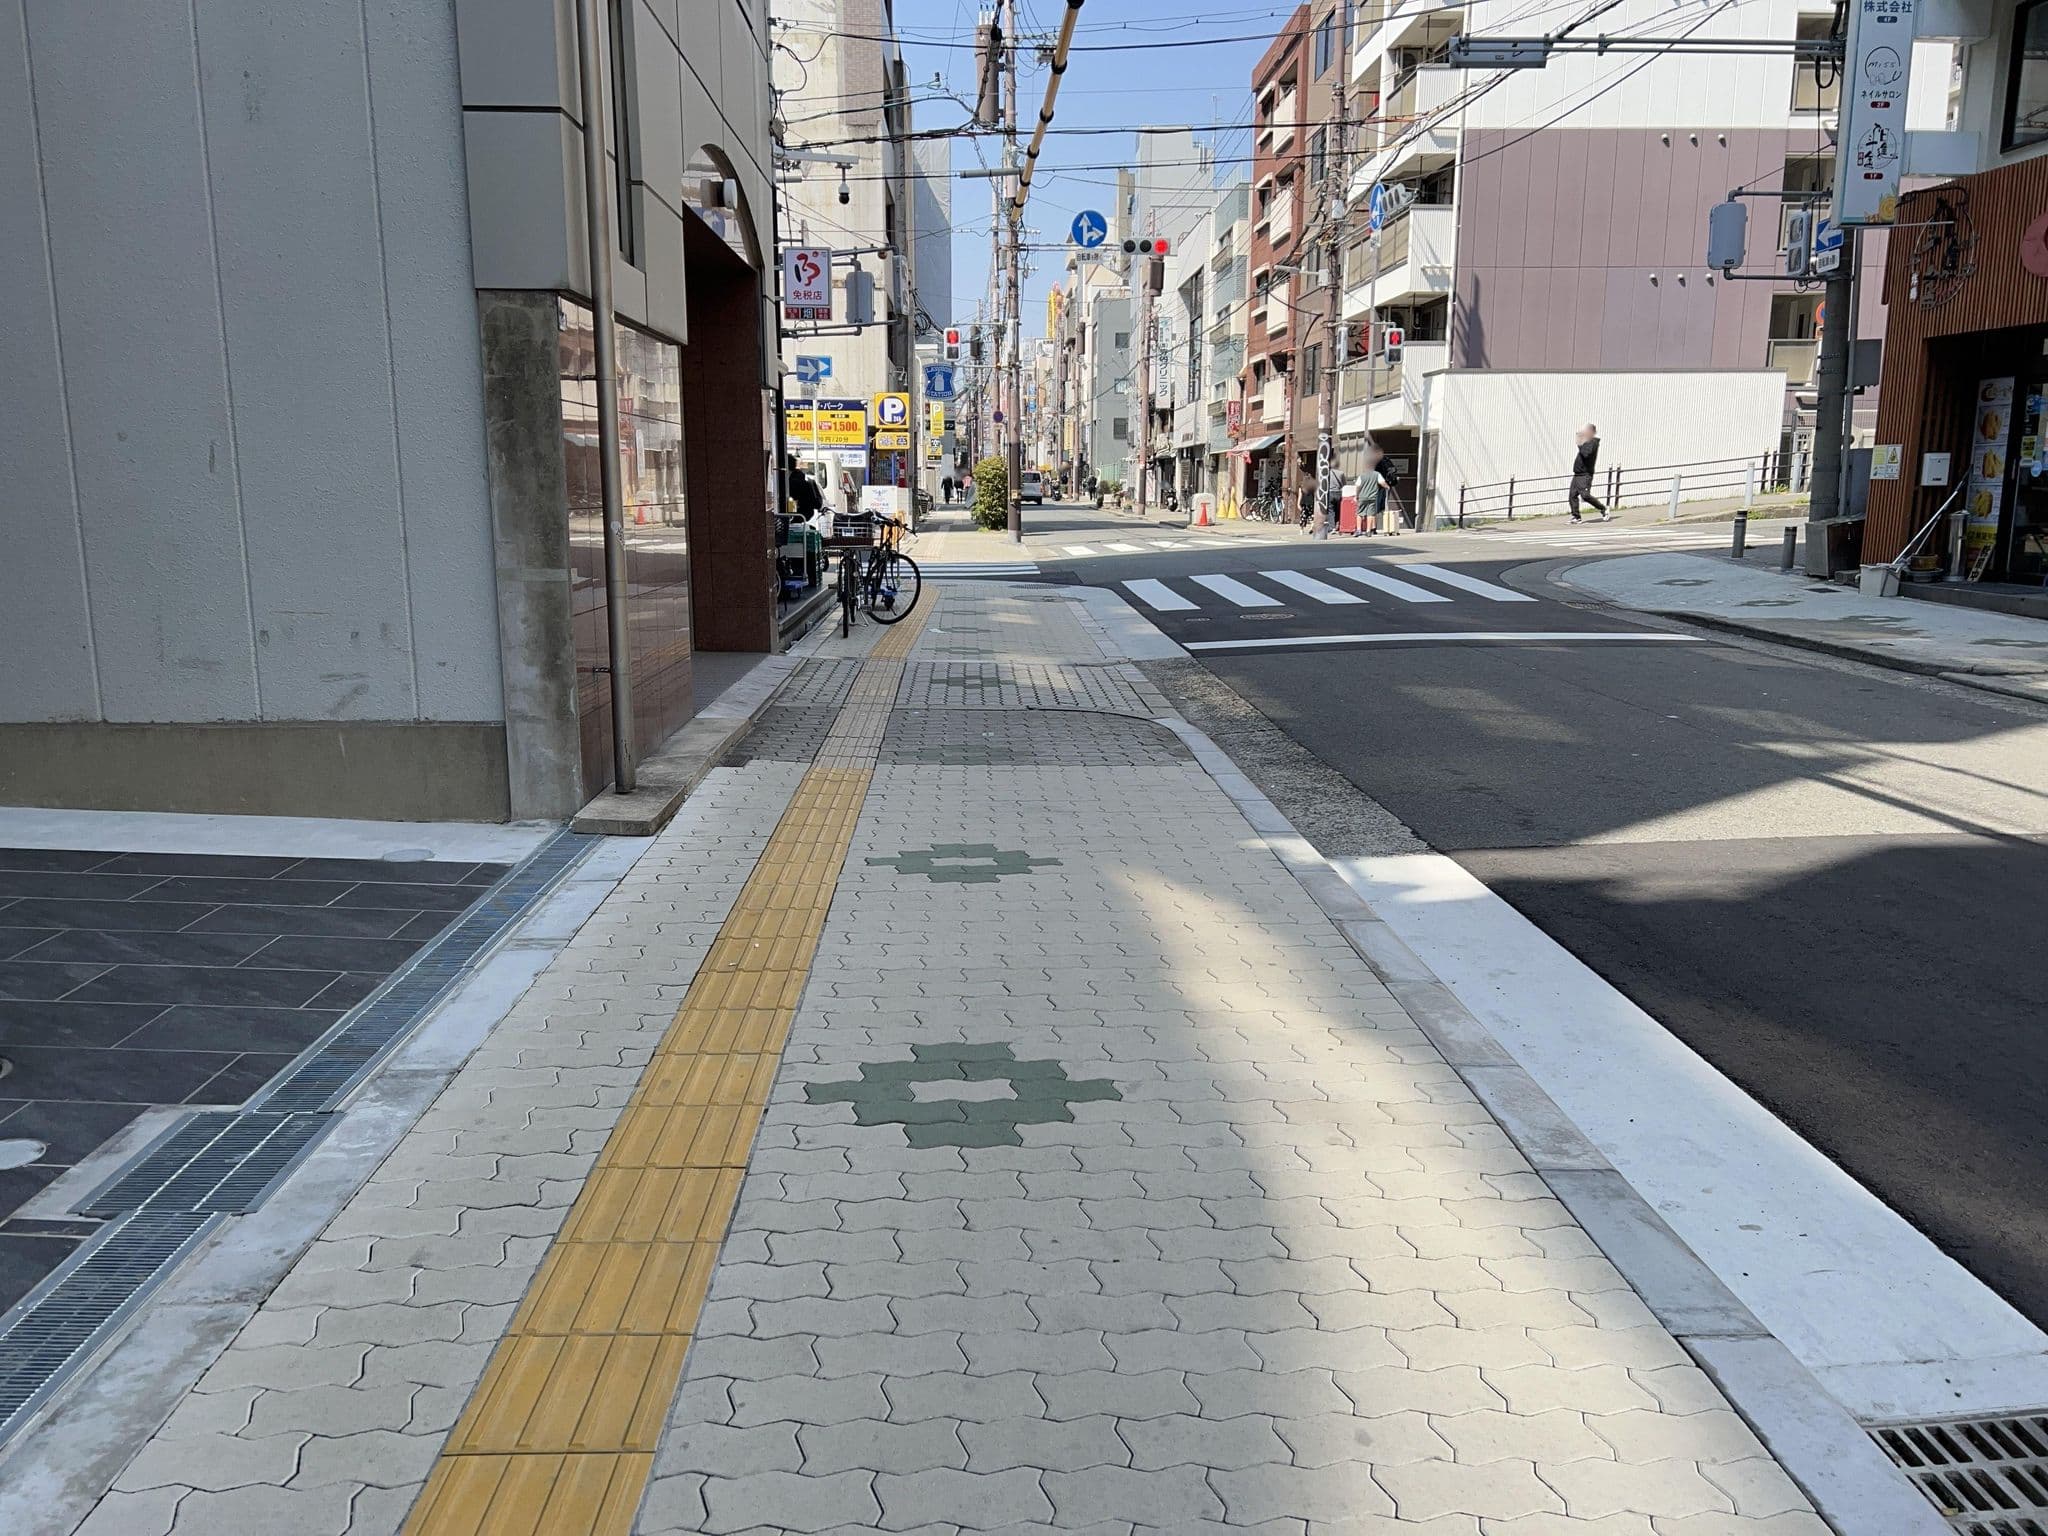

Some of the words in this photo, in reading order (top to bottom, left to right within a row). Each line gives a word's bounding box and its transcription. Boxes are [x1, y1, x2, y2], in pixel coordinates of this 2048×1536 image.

[1864, 0, 1912, 13] 株式会社
[1861, 90, 1901, 98] ネイルサロン
[793, 290, 822, 300] 免税店
[884, 398, 903, 422] P
